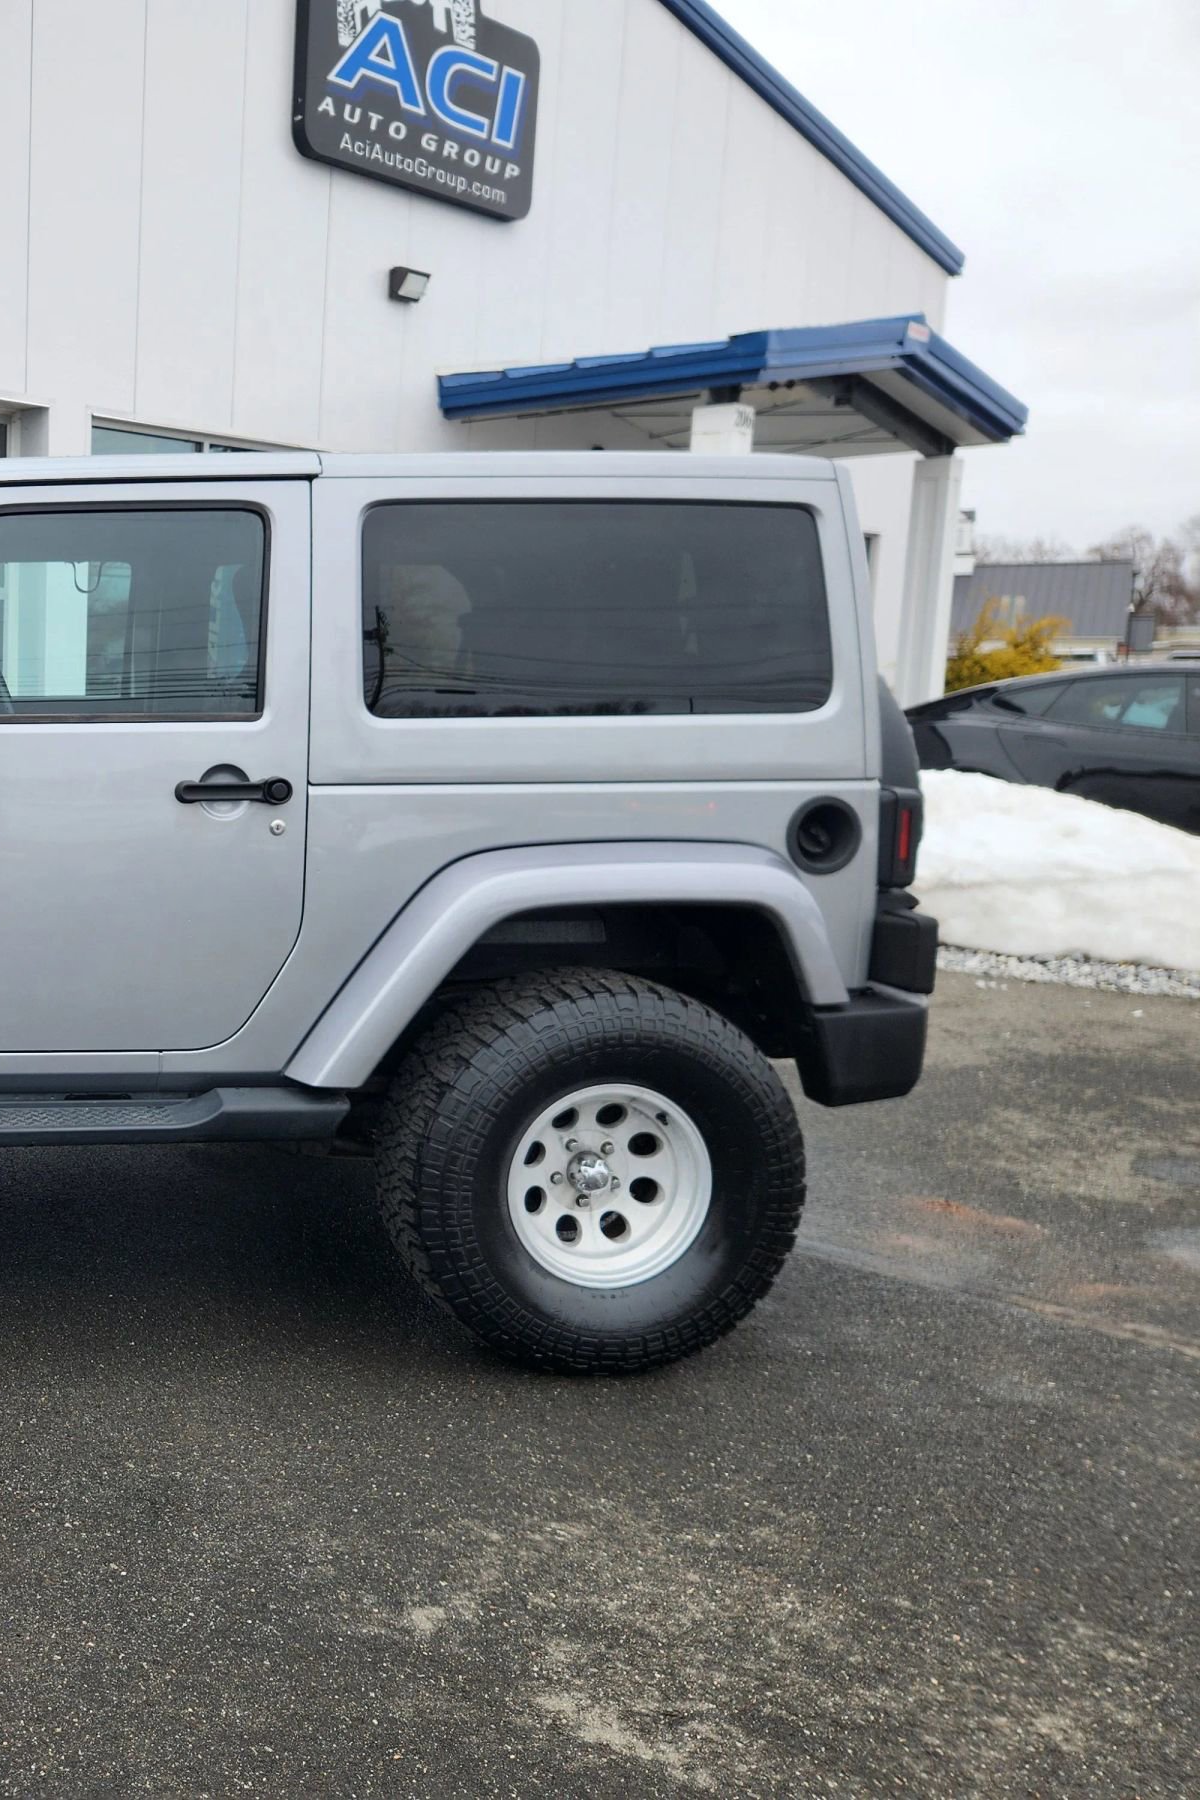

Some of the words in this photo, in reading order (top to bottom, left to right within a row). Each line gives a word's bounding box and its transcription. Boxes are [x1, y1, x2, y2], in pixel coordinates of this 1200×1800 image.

[326, 10, 526, 150] ACI
[317, 95, 408, 141] AUTO
[420, 132, 522, 180] GROUP
[339, 132, 507, 205] AciAutoGroup.com
